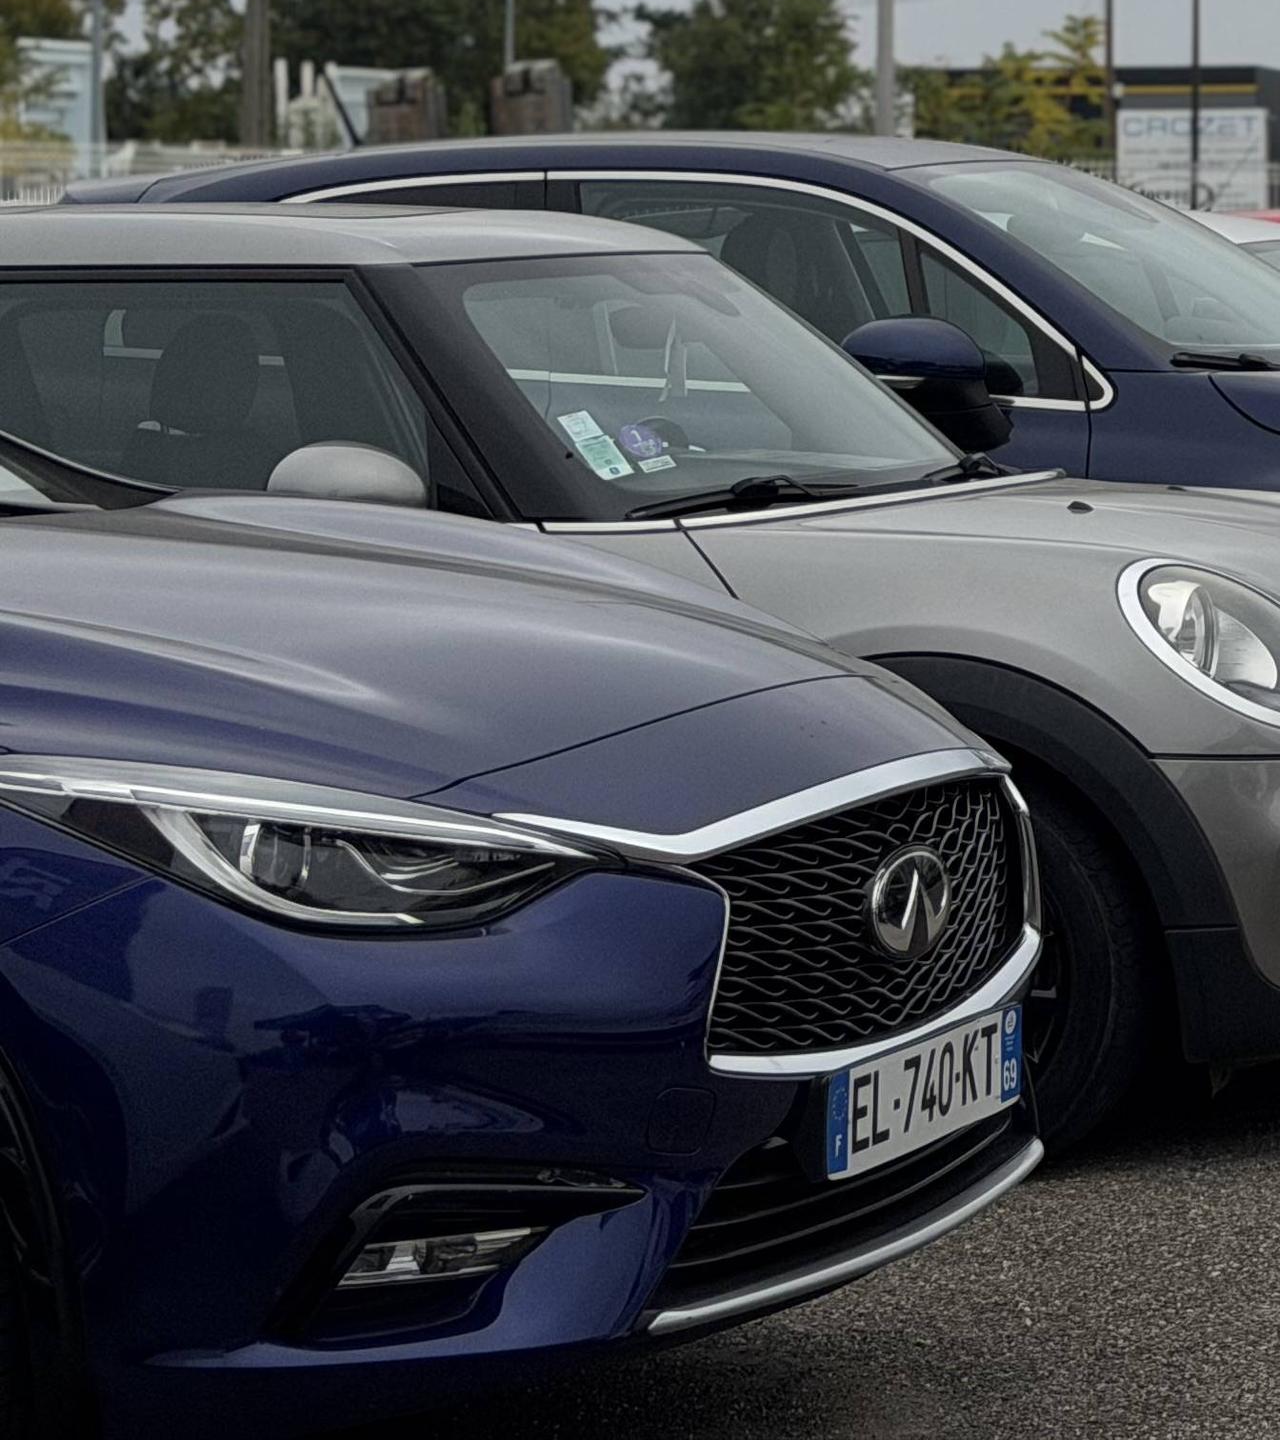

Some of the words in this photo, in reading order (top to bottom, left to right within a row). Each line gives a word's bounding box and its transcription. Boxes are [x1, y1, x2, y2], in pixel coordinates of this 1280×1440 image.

[1123, 116, 1258, 137] CROZET
[851, 1022, 998, 1155] EL-740-KT
[1003, 1057, 1017, 1092] 69
